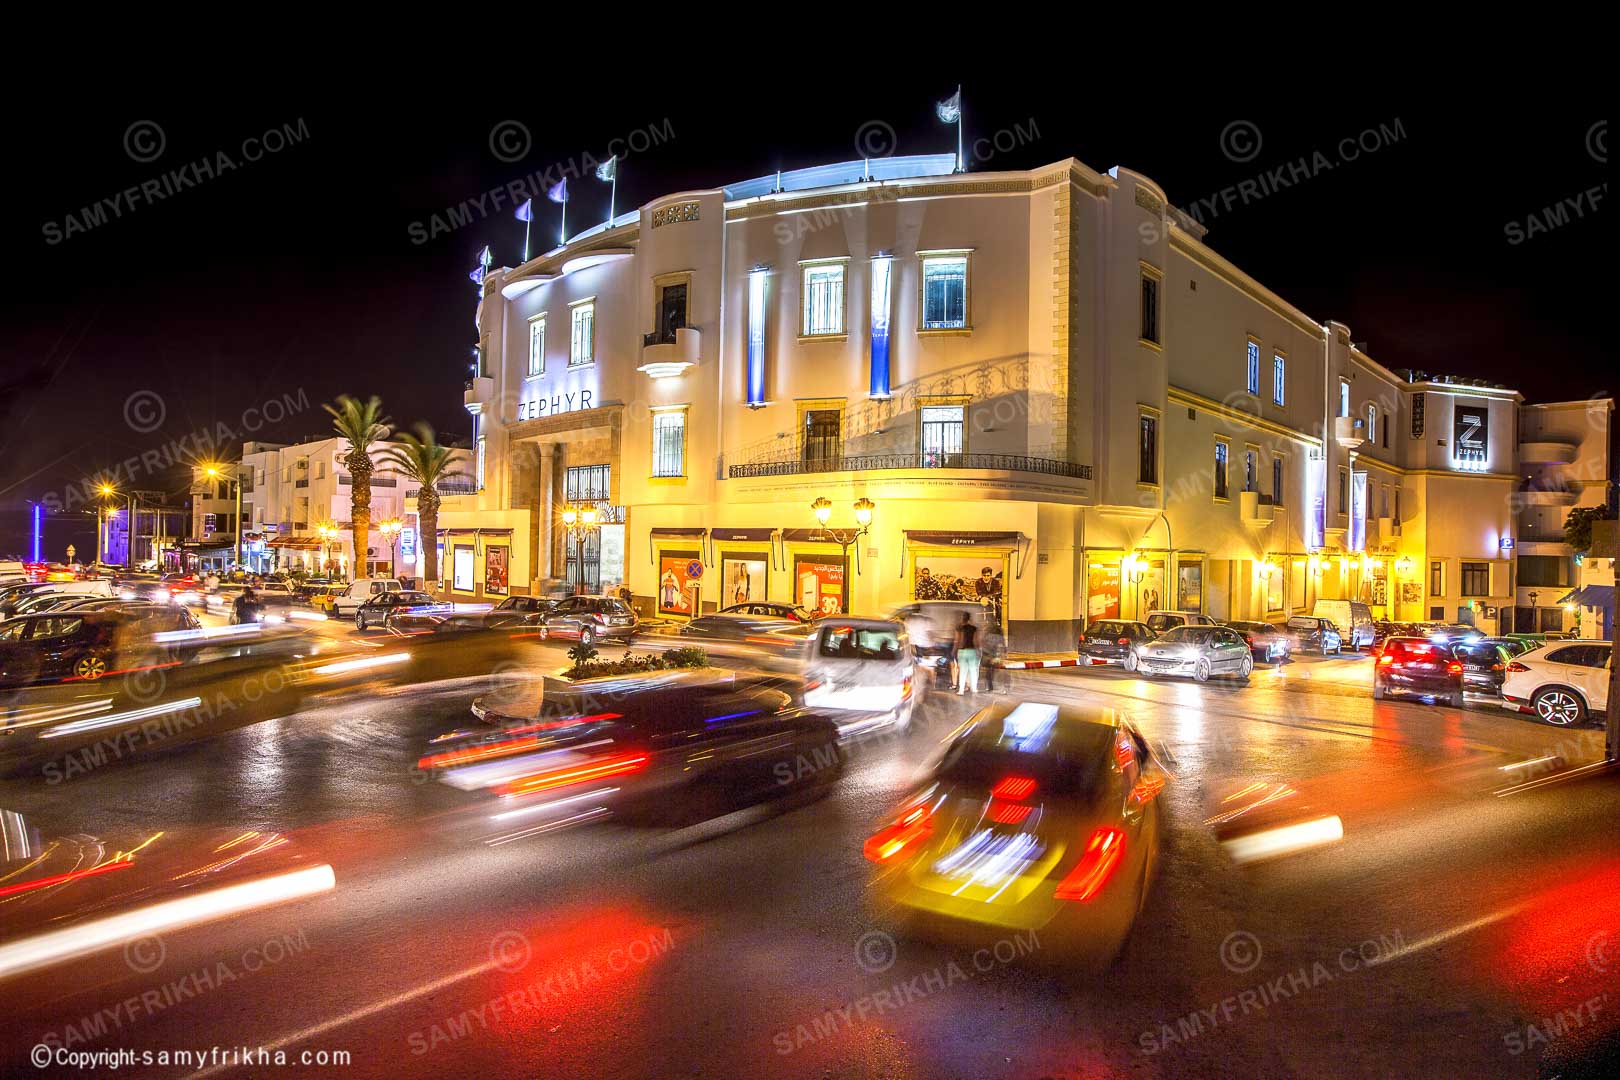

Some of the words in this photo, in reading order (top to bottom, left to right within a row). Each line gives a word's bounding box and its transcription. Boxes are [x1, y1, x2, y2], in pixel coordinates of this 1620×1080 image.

[518, 390, 592, 421] ZEPHYR
[1460, 414, 1483, 448] Z
[1459, 448, 1484, 456] ZEPHYR
[822, 596, 838, 614] 39
[1487, 608, 1496, 616] P
